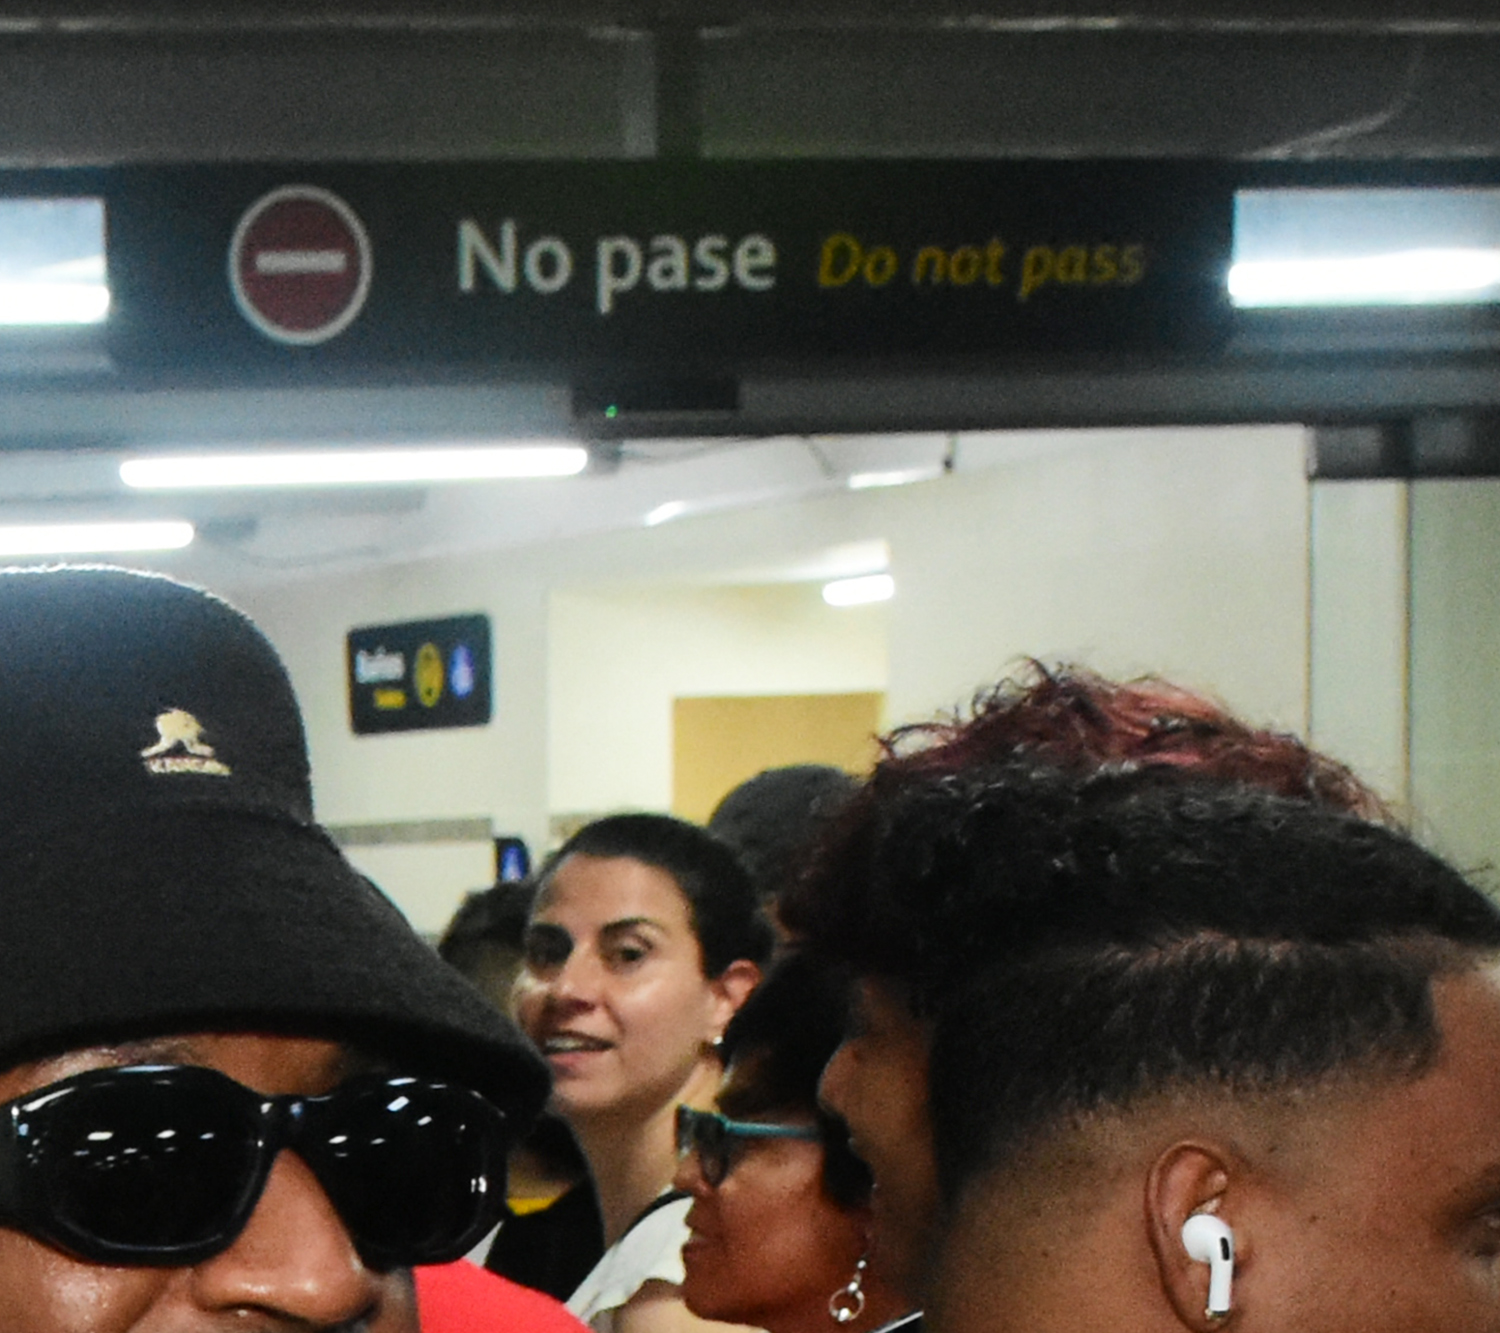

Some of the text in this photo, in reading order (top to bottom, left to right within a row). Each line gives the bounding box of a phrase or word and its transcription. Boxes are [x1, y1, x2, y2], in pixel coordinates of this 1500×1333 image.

[457, 218, 1146, 315] No pase Do not pass
